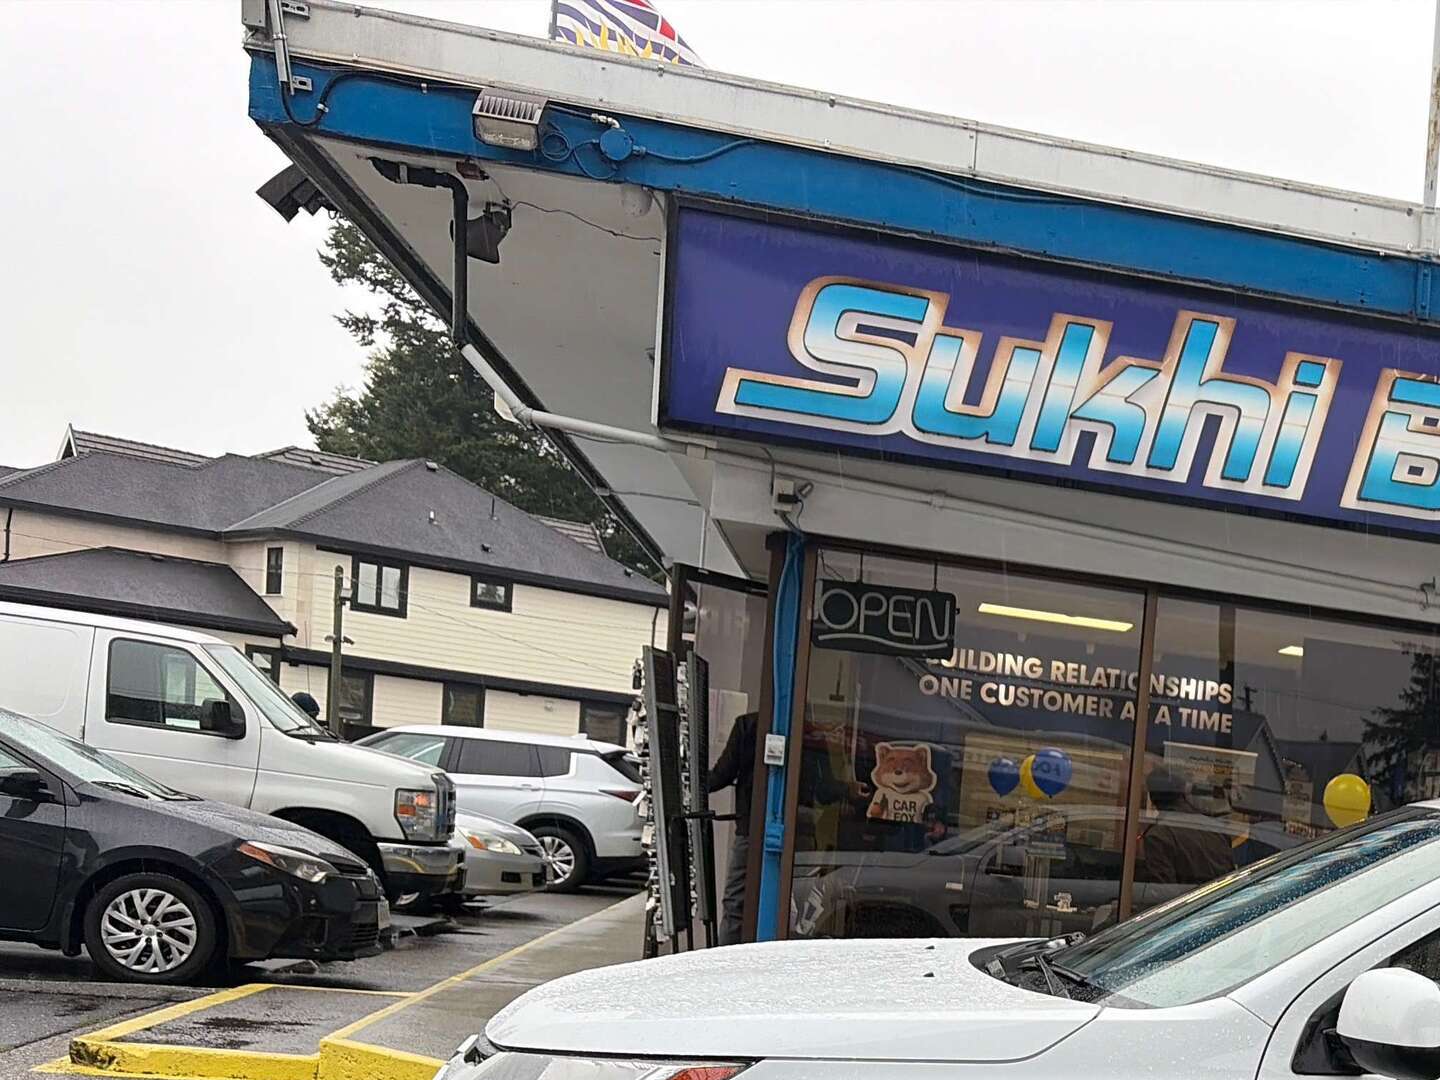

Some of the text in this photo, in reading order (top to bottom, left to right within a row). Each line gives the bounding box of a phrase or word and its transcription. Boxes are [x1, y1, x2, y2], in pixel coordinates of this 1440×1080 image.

[715, 275, 1342, 501] Sukhi
[819, 588, 951, 641] OPEN
[926, 648, 1044, 679] UILDING
[919, 674, 973, 700] ONE
[980, 682, 1113, 718] CUSTOMER
[1154, 704, 1172, 726] A
[1178, 706, 1233, 733] TIME
[893, 800, 917, 812] CAR
